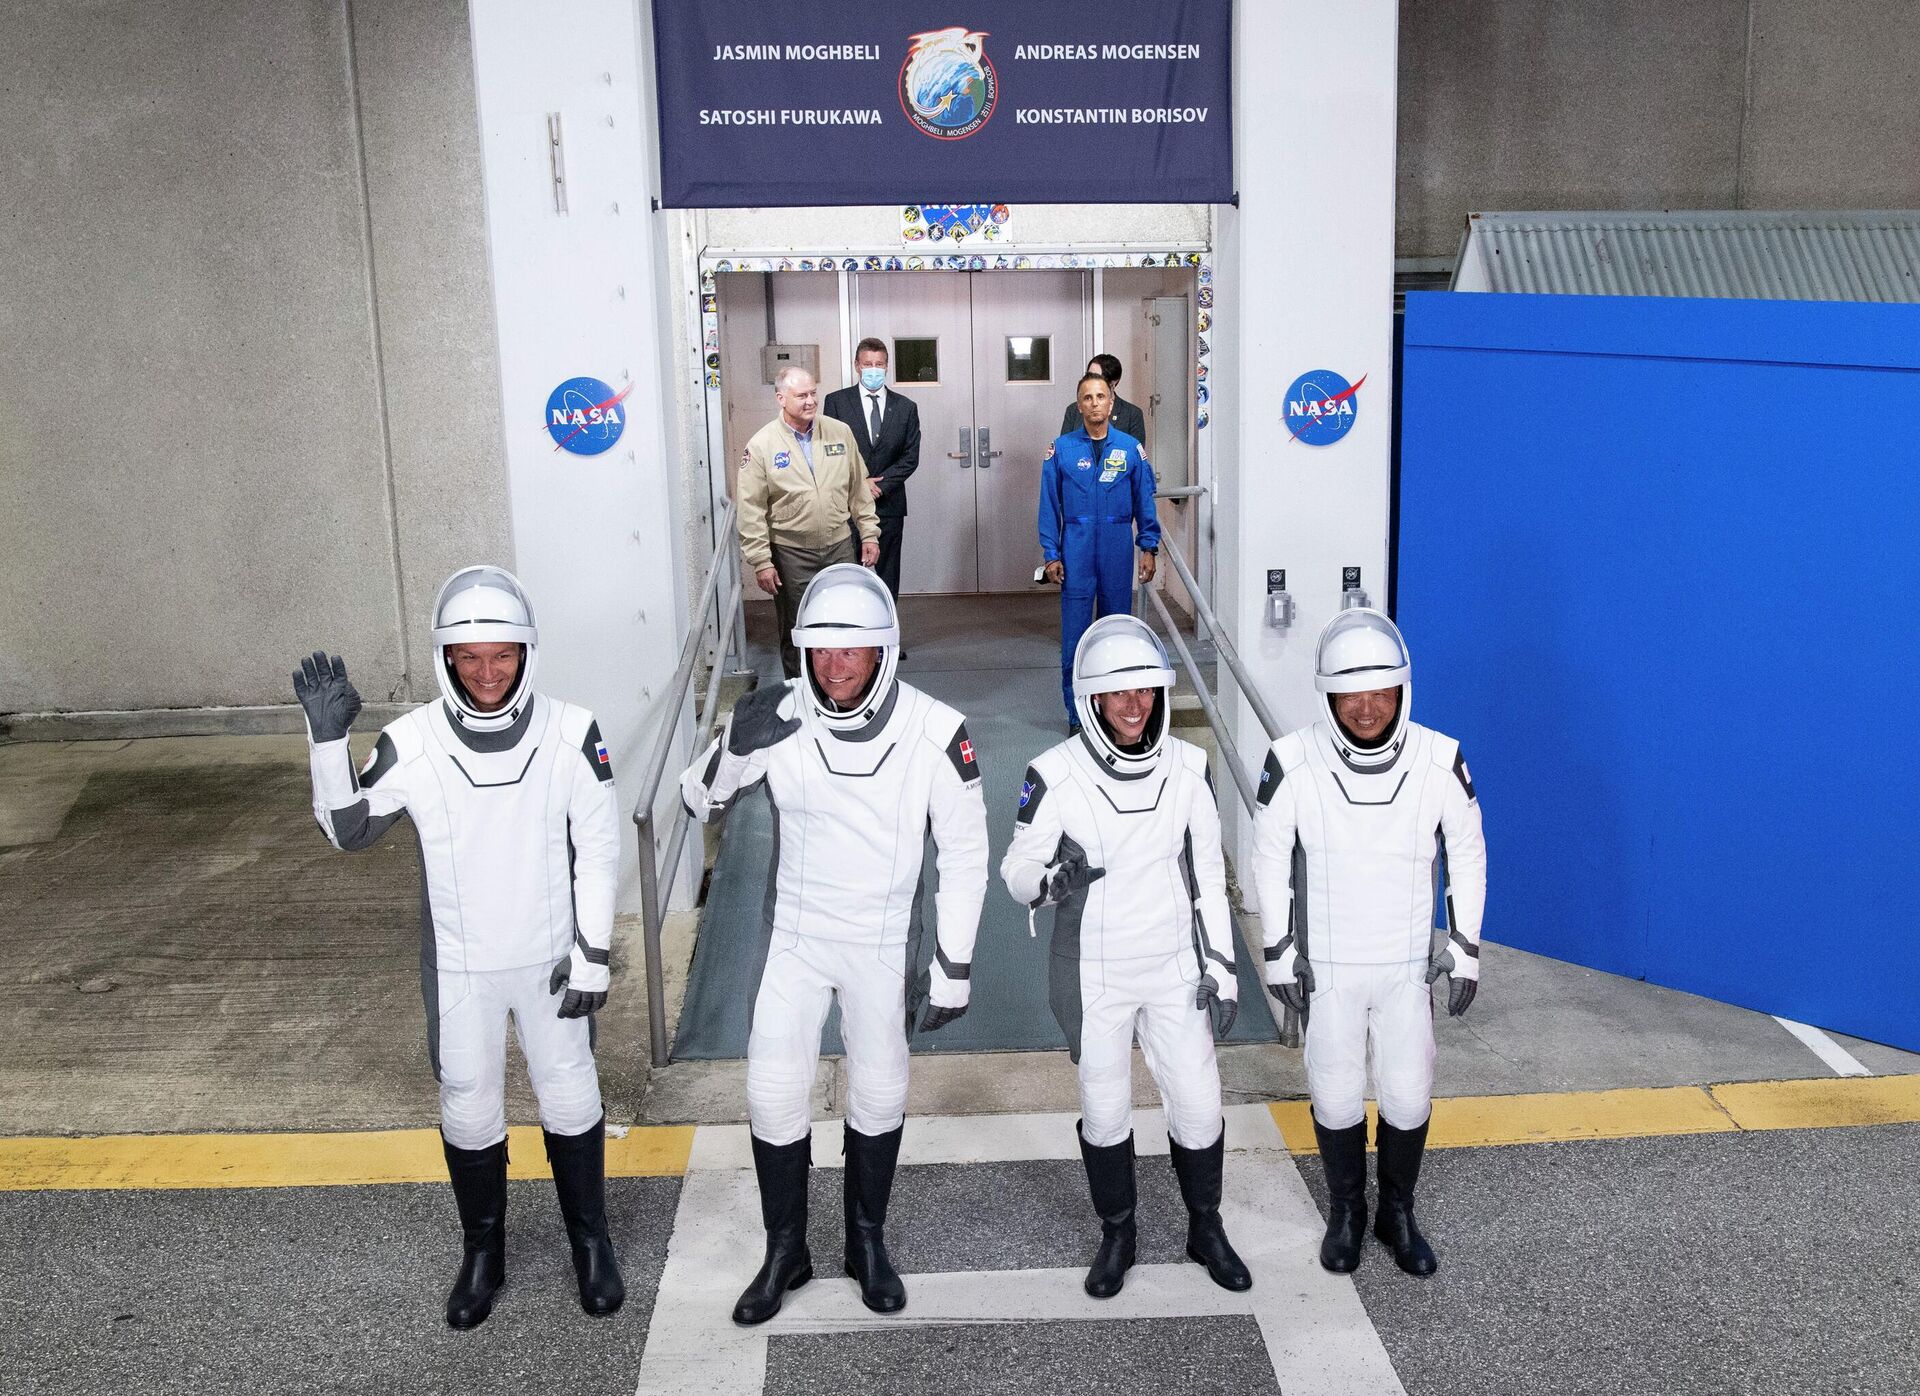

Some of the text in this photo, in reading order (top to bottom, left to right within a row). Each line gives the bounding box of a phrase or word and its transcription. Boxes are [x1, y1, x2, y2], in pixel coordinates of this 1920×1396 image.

[713, 45, 880, 60] JASMIN MOGHBELI
[1014, 44, 1200, 60] ANDREAS MOGENSEN
[983, 65, 995, 99] БОРИСОВ
[699, 109, 882, 125] SATOSHI FURUKAWA
[1016, 107, 1208, 124] KONSTANTIN BORISOV
[911, 113, 982, 136] MOGHBELI MOGENSEN
[552, 408, 621, 425] NASA
[1289, 399, 1353, 417] NASA
